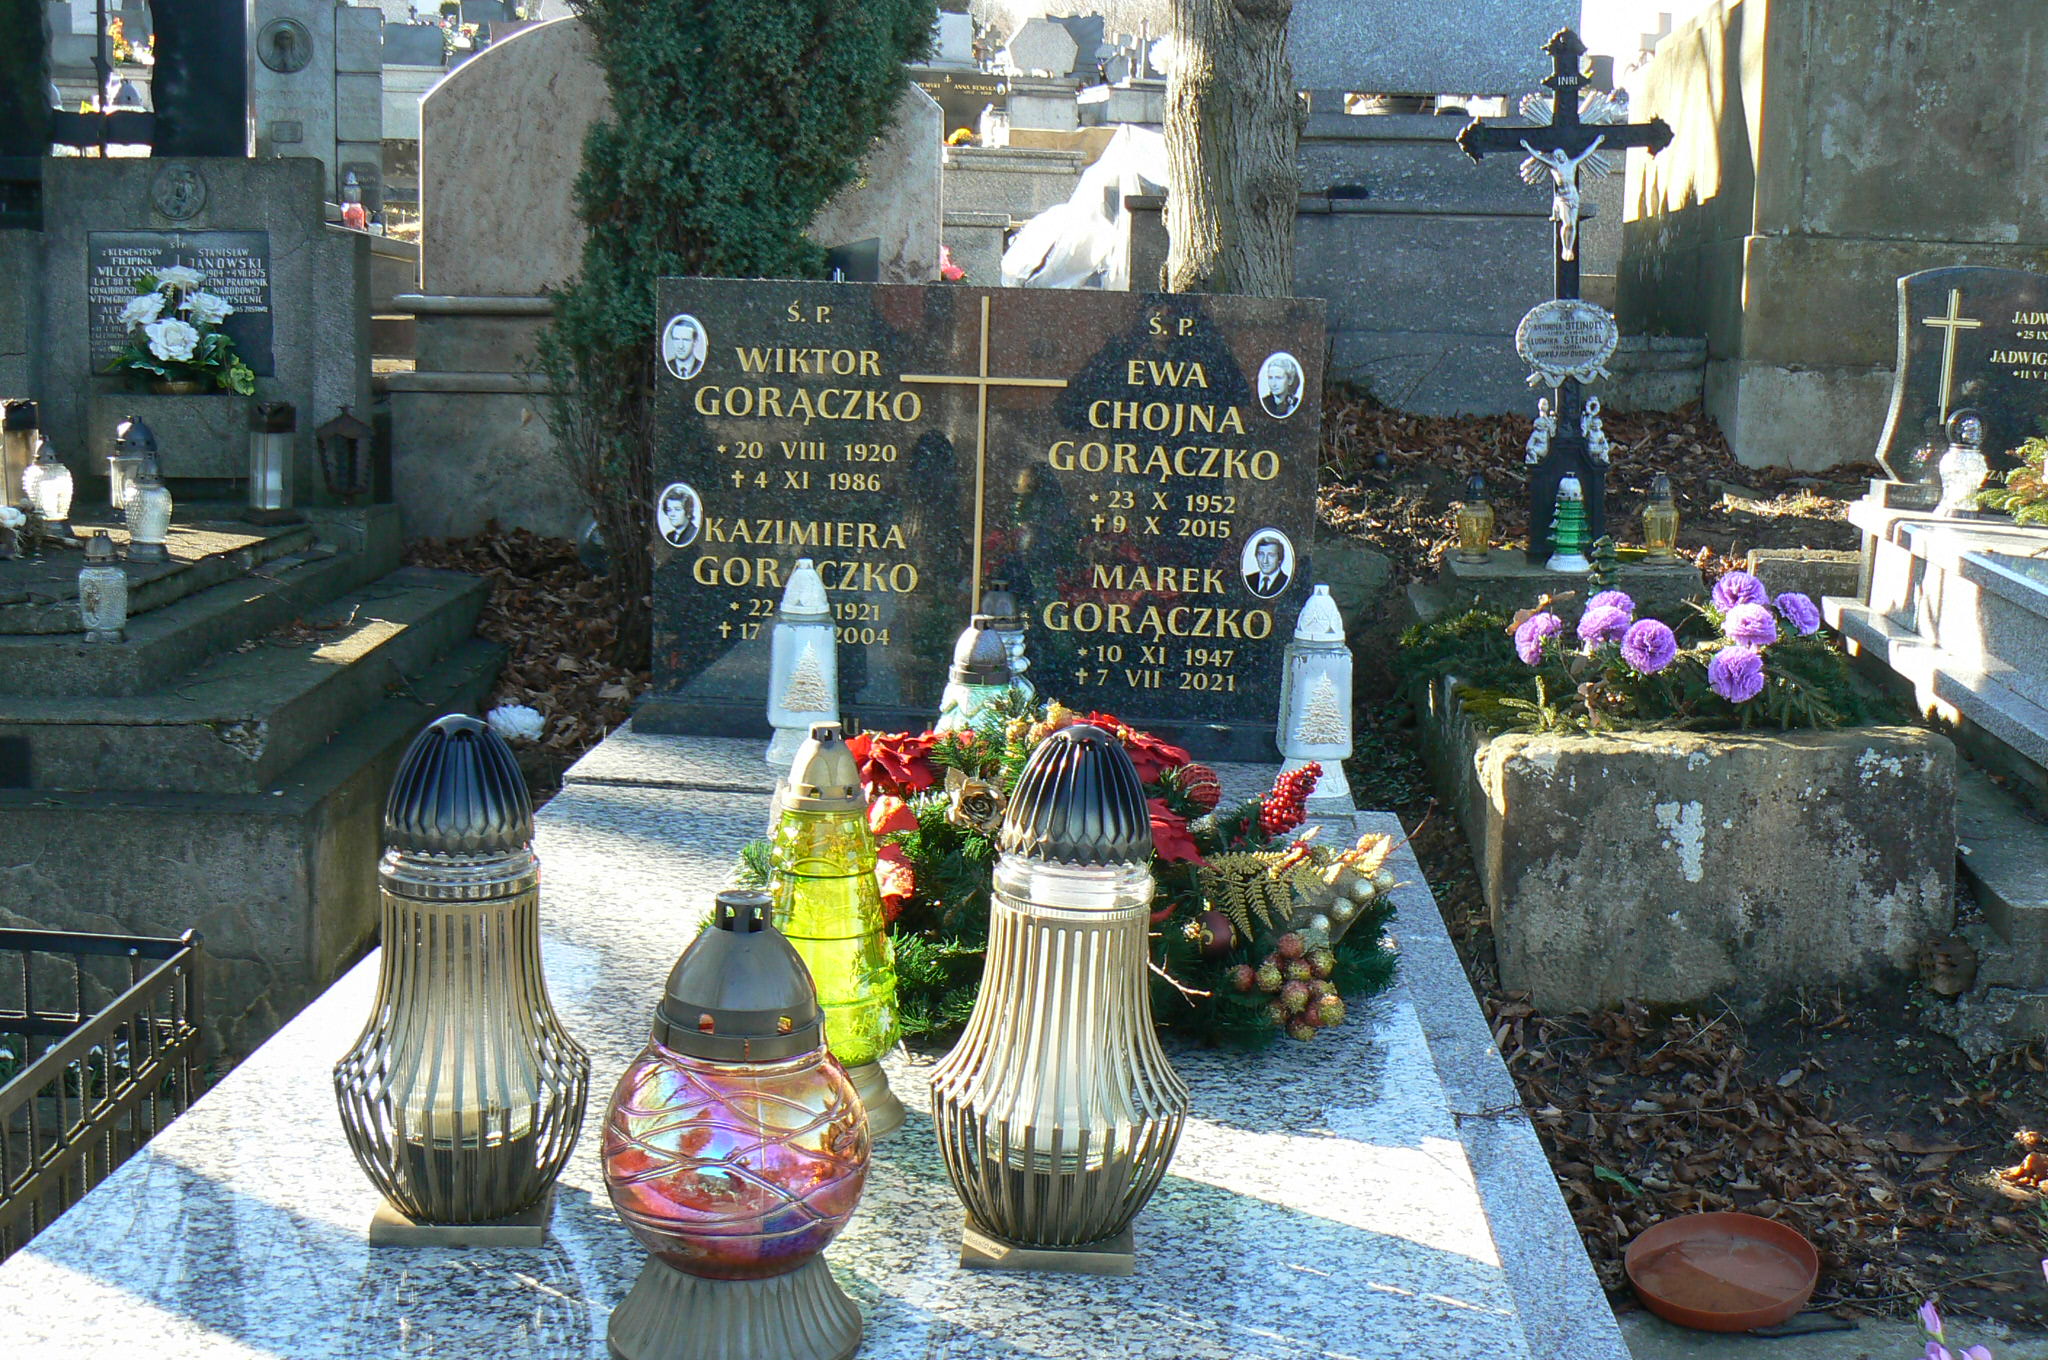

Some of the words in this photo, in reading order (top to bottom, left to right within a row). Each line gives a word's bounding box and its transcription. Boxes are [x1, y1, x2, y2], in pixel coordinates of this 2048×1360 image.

[1557, 76, 1578, 86] INRI
[112, 257, 153, 266] FILIPINA
[190, 257, 261, 269] JANOWSKI
[94, 278, 110, 286] LAT
[226, 278, 268, 287] PRACOWNIK
[816, 306, 832, 323] P.
[1565, 321, 1603, 330] STEINDEL
[1178, 318, 1194, 337] P.
[1564, 335, 1603, 344] STEINDEL
[735, 347, 882, 377] WIKTOR
[1127, 360, 1208, 389] EWA
[695, 385, 922, 425] GORĄCZKO
[1088, 400, 1245, 437] CHOJNA
[735, 441, 763, 459] 20
[781, 442, 826, 460] VIII
[845, 443, 897, 463] 1920
[1048, 441, 1281, 483] GORĄCZKO
[754, 473, 768, 489] 4
[783, 471, 810, 489] XI
[828, 472, 881, 492] 1986
[1108, 491, 1135, 510] 23
[1151, 492, 1168, 511] X
[1186, 494, 1236, 514] 1952
[705, 517, 907, 550] KAZIMIERA
[1113, 515, 1126, 533] 9
[1144, 516, 1160, 535] X
[1177, 518, 1231, 539] 2015
[692, 555, 919, 593] GORCZKO
[1092, 564, 1226, 594] MAREK
[749, 599, 774, 617] 22
[835, 603, 880, 621] 1921
[1042, 600, 1273, 642] GORĄCZKO
[740, 623, 760, 641] 17
[835, 627, 890, 646] 2004
[1097, 645, 1122, 662] 10
[1140, 646, 1166, 665] XI
[1184, 647, 1234, 667] 1947
[1097, 669, 1108, 686] 7
[1125, 669, 1160, 689] VII
[1179, 672, 1236, 692] 2021
